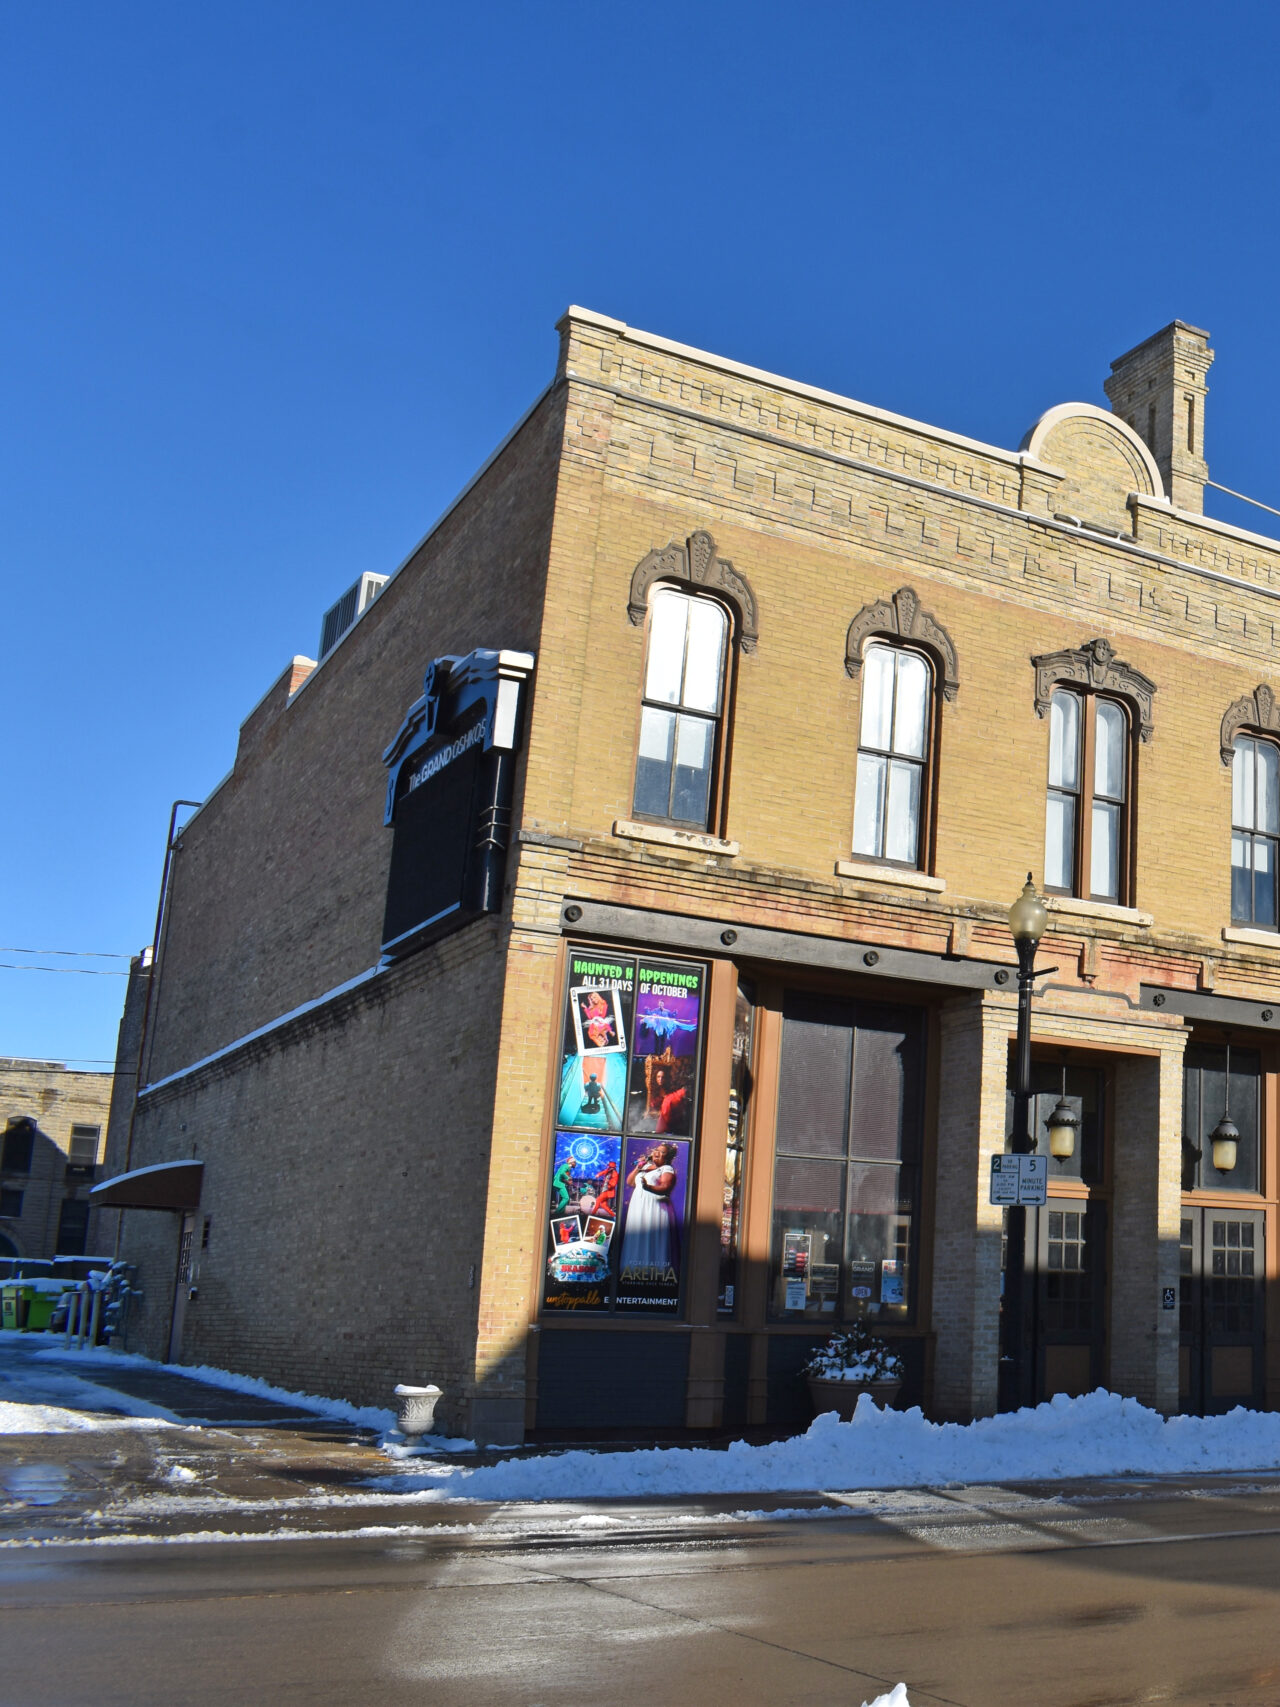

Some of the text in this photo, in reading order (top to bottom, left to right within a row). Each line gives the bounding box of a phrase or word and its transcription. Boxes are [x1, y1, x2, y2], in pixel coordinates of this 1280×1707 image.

[409, 718, 487, 792] The GRAND OSHKOS
[574, 960, 622, 978] HAUNTED
[582, 975, 688, 999] ALL 31 DAYS OF OCTOBER
[993, 1159, 1000, 1169] 2
[1029, 1160, 1036, 1172] 5
[620, 1266, 678, 1283] ARETHA
[546, 1290, 679, 1311] unstoppable ENTERTAINMENT
[855, 1287, 868, 1297] OPEN
